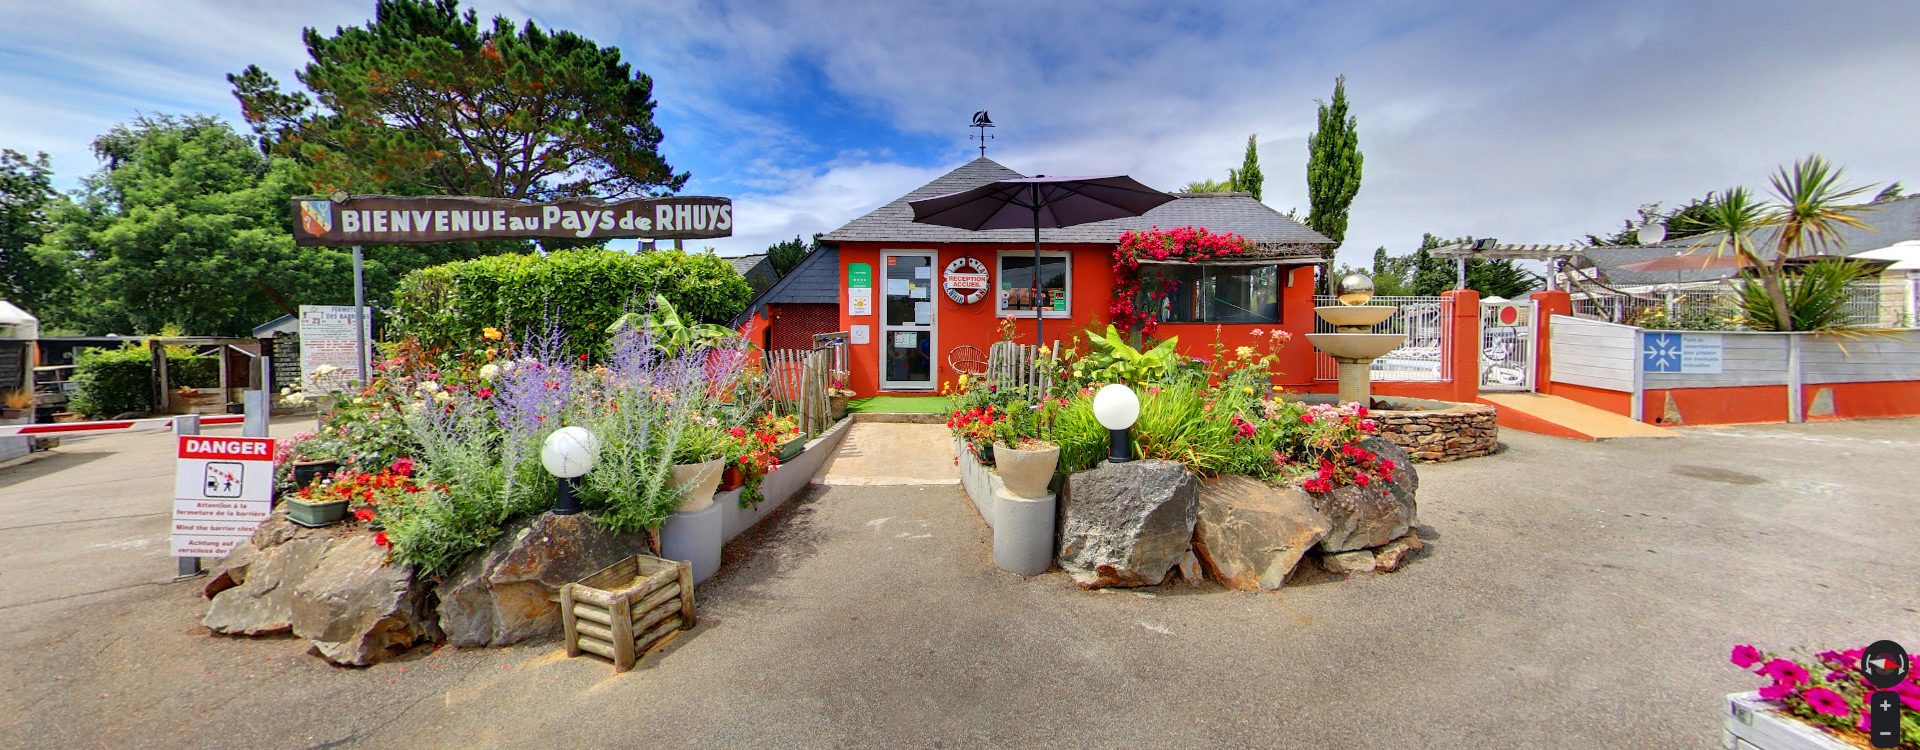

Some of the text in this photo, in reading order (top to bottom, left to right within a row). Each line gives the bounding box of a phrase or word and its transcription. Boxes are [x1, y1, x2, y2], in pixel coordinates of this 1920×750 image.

[341, 204, 732, 238] BIENVENUE au Pays de RHUYS
[186, 440, 267, 455] DANGER
[188, 540, 219, 548] Achtung
